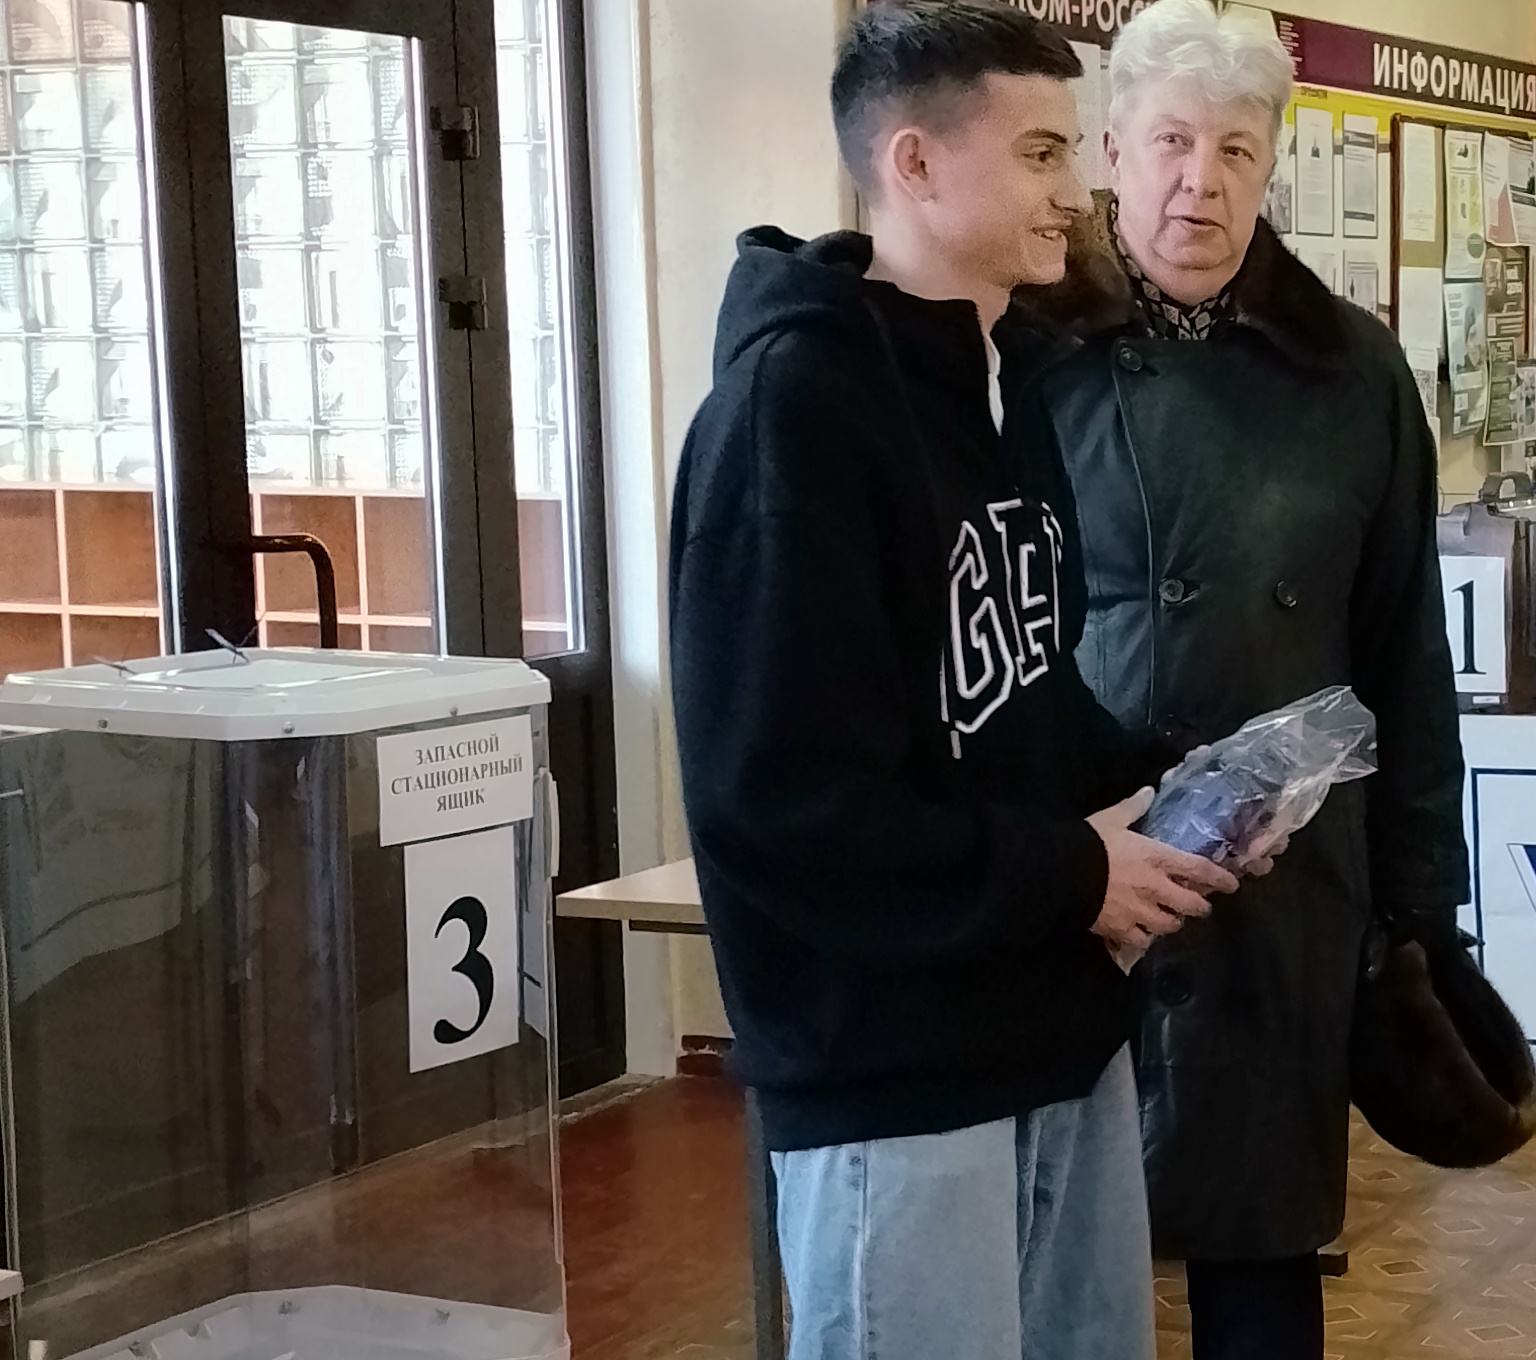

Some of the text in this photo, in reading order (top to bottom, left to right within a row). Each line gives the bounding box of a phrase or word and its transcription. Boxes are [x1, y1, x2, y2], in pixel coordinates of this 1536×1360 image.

[1451, 579, 1487, 676] 1
[415, 732, 500, 766] ЗАПАСНОЙ
[391, 754, 524, 795] СТАЦИОНАРНЫЙ
[436, 788, 485, 812] ЯЩИК
[434, 896, 494, 1044] 3
